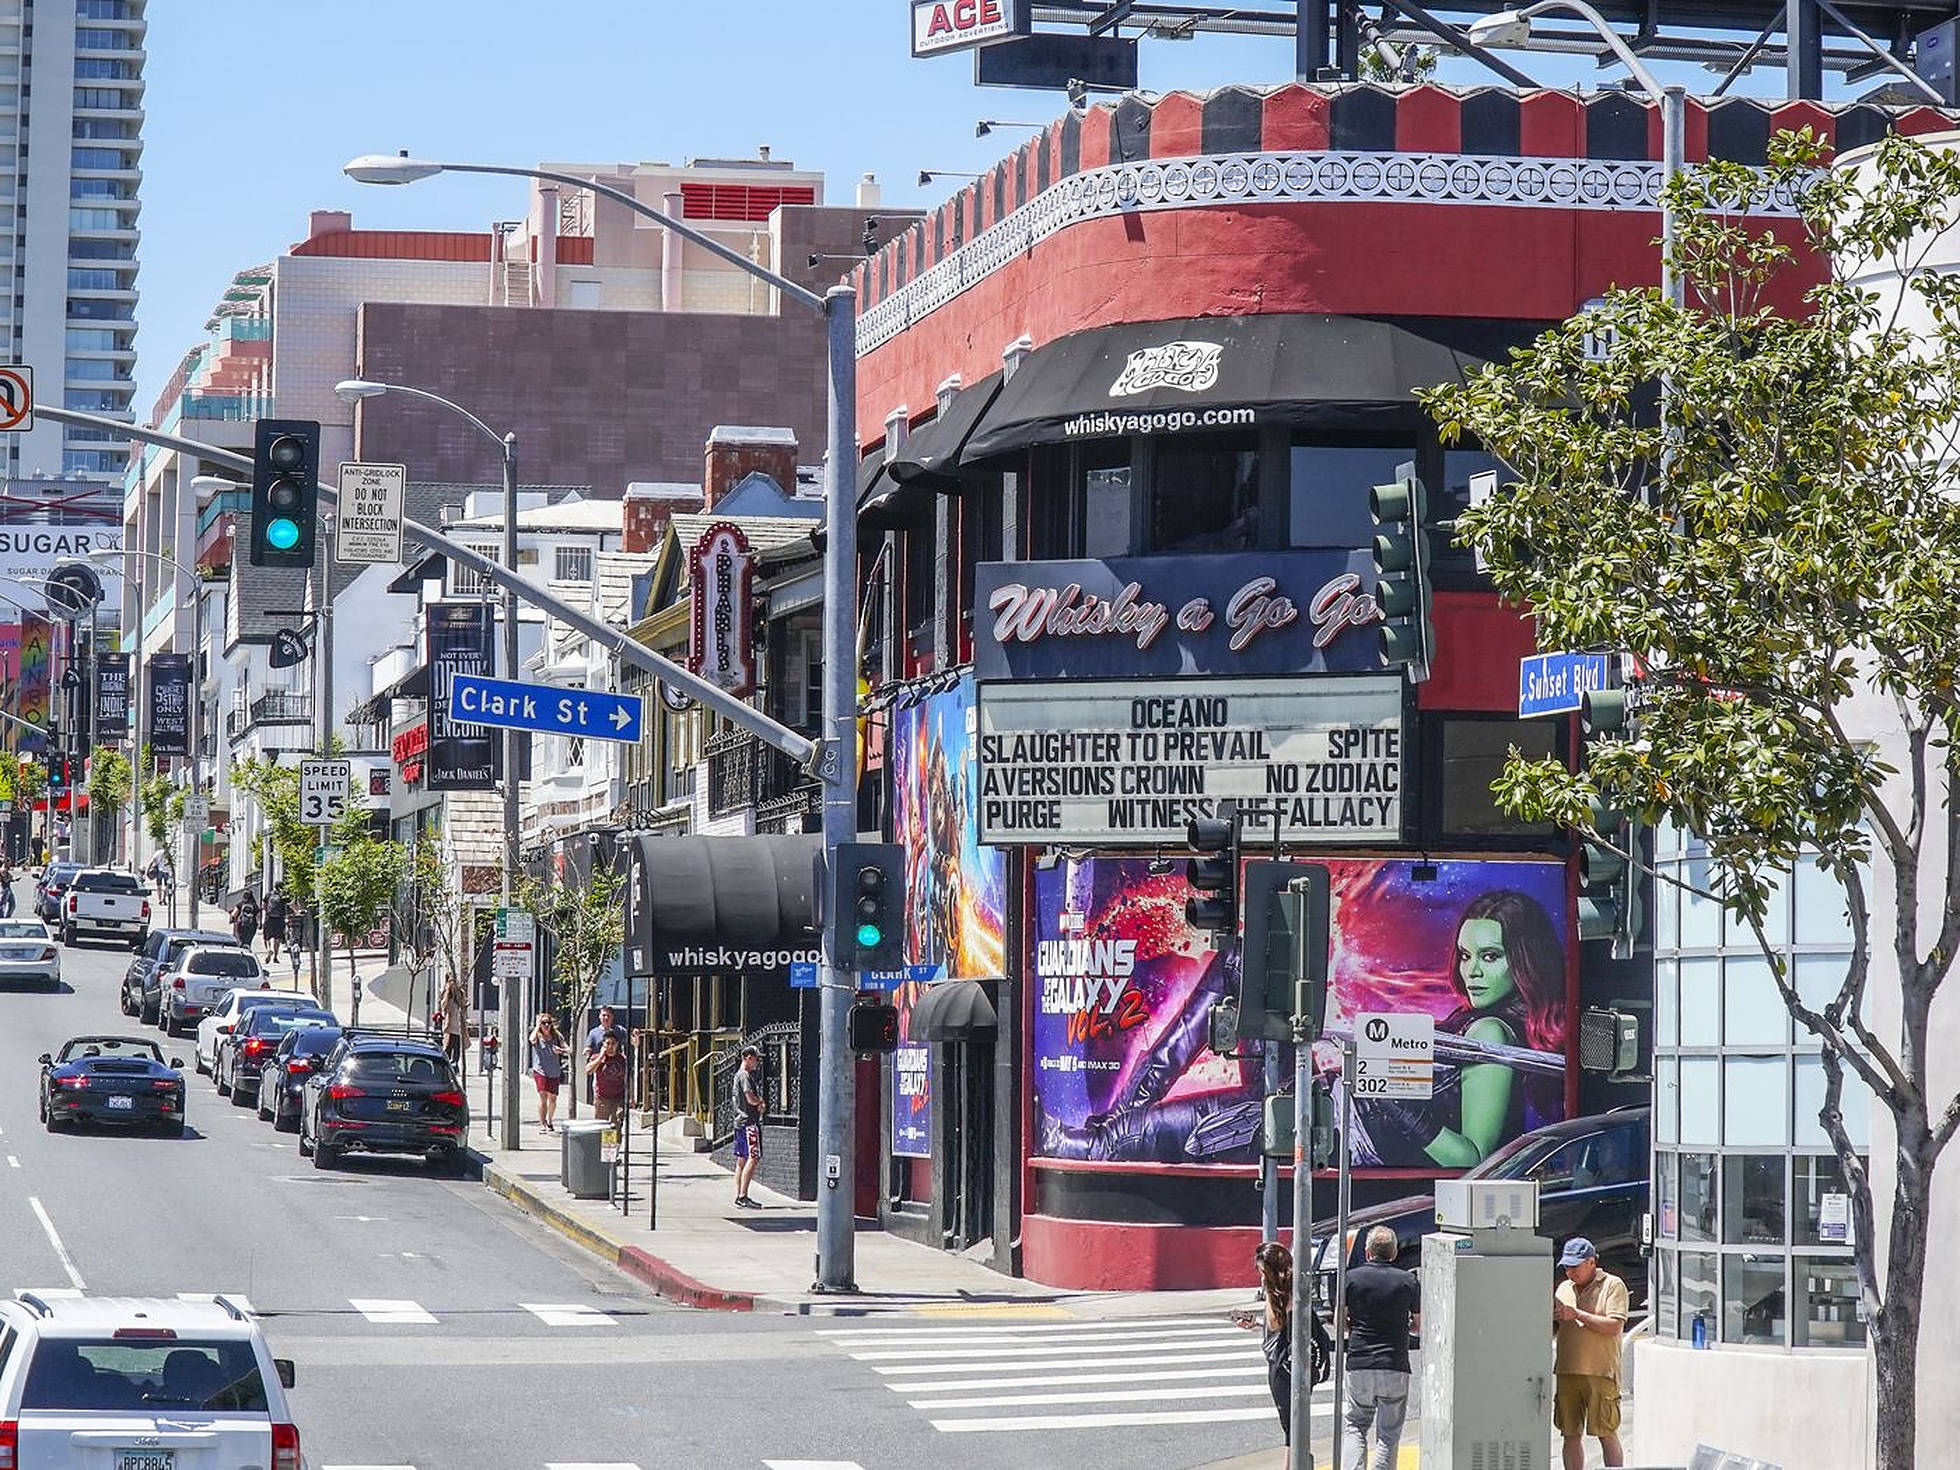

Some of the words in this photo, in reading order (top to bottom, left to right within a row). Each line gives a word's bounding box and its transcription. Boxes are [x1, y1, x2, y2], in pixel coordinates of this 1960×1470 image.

[928, 0, 1001, 37] ACE
[920, 35, 955, 47] OUTDOOR
[960, 23, 1008, 38] ADVERTISING
[1064, 408, 1256, 435] whiskyagogo.com
[344, 468, 401, 479] ANTI-GRIDLOCK
[361, 478, 382, 486] ZONE
[355, 488, 367, 500] DO
[372, 488, 388, 501] NOT
[357, 503, 385, 516] BLOCK
[343, 517, 398, 532] INTERSECTION
[0, 533, 90, 554] SUGAR
[8, 567, 38, 576] SUGAR
[989, 582, 1168, 650] Whisky
[1177, 597, 1214, 632] a
[1226, 576, 1297, 651] Go
[1310, 573, 1381, 648] Go
[440, 652, 457, 660] NOT
[100, 672, 126, 681] THE
[1527, 669, 1567, 702] Sunset
[1573, 660, 1599, 693] Blvd
[156, 705, 184, 713] ONLY
[460, 687, 537, 719] Clark
[556, 698, 589, 726] St
[1131, 698, 1228, 729] OCEANO
[982, 732, 1121, 764] SLAUGHTER
[1126, 731, 1158, 761] TO
[1164, 729, 1271, 761] PREVAIL
[1328, 728, 1399, 760] SPITE
[304, 766, 348, 777] SPEED
[983, 765, 1115, 797] AVERSIONS
[1120, 765, 1205, 796] CROWN
[1265, 763, 1299, 794] NO
[1306, 762, 1398, 793] ZODIAC
[308, 781, 343, 791] LIMIT
[305, 795, 345, 818] 35
[986, 799, 1061, 829] PURGE
[1108, 798, 1214, 828] WITNESS
[1228, 797, 1270, 827] HE
[1278, 797, 1393, 828] FALLACY
[1037, 940, 1138, 976] GUARDIANS
[1050, 978, 1128, 1014] GALAXY
[1120, 989, 1150, 1029] 2
[1391, 1038, 1428, 1050] Metro
[1358, 1060, 1367, 1075] 2
[1357, 1078, 1387, 1093] 302
